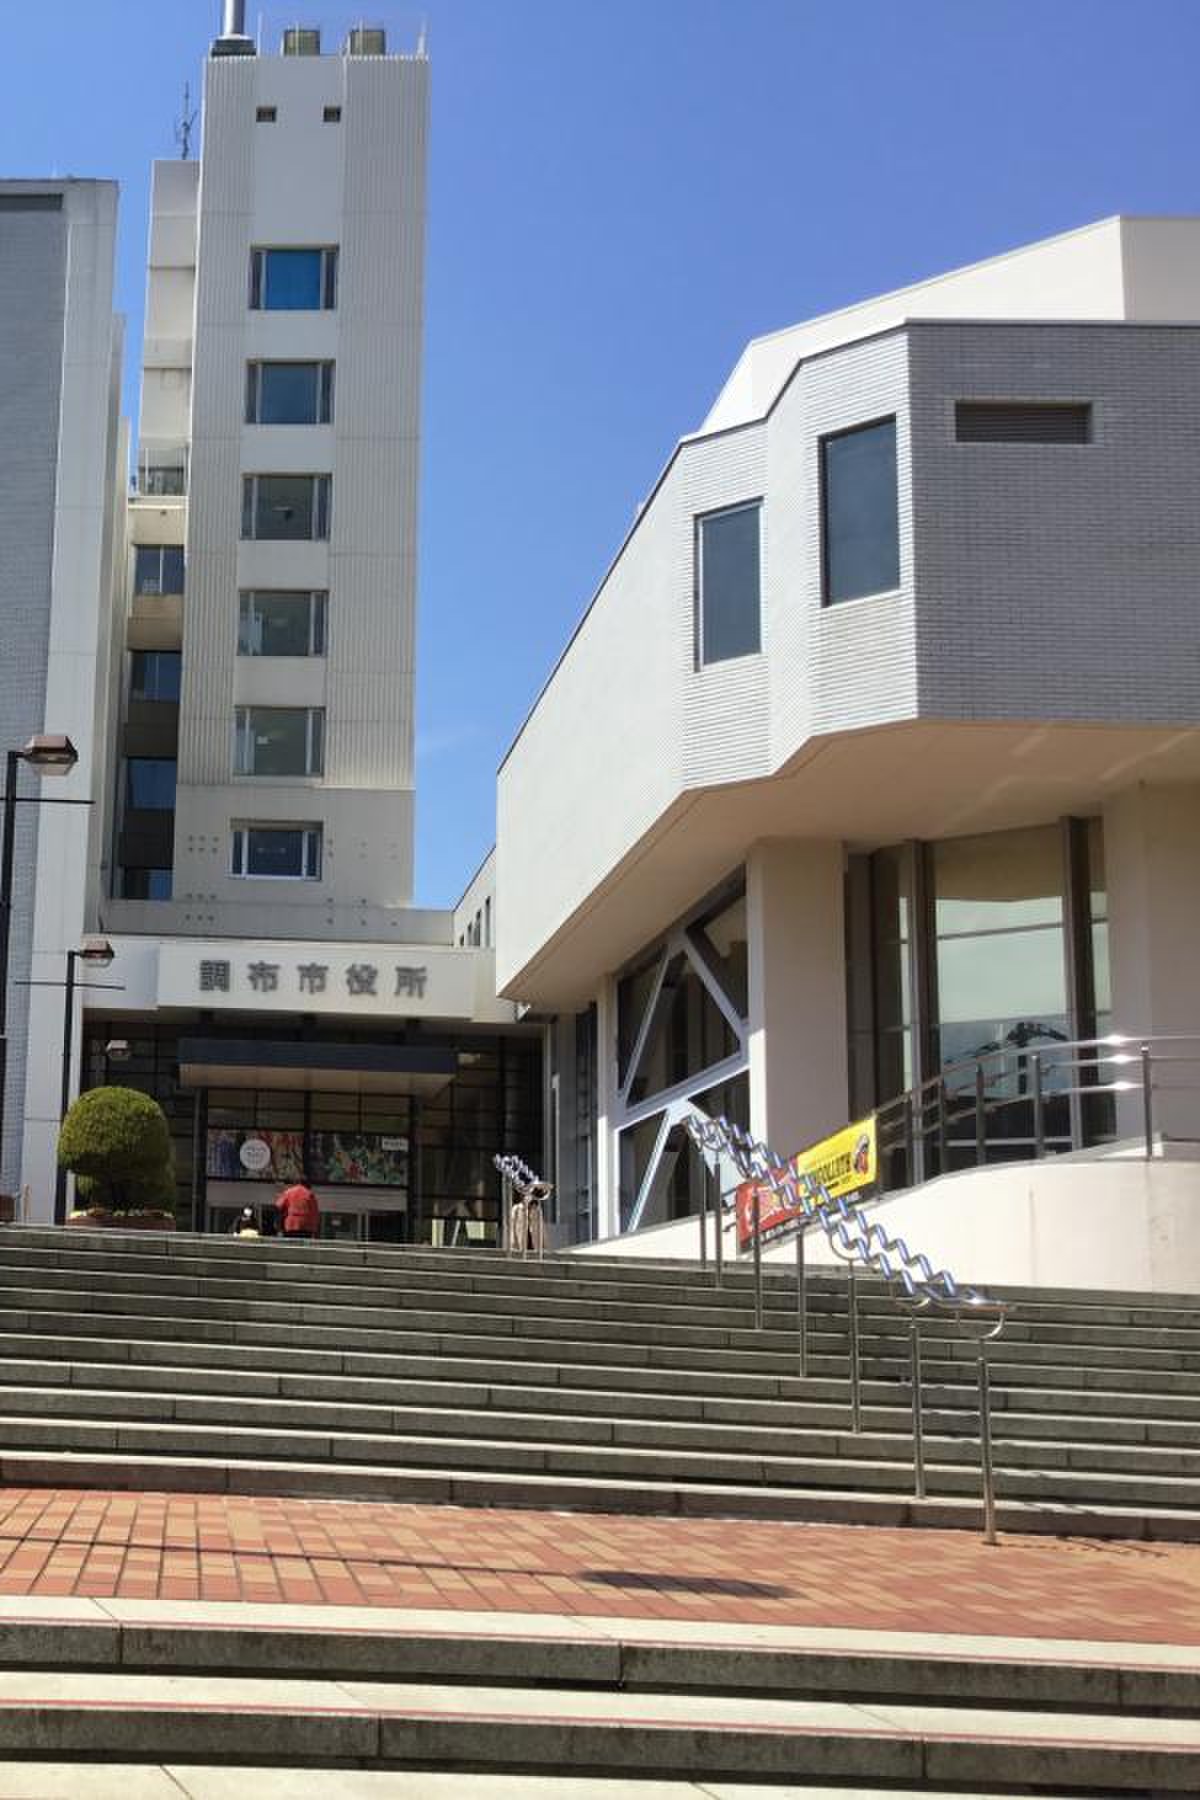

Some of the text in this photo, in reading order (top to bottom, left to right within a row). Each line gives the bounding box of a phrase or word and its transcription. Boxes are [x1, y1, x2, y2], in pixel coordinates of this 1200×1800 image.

[199, 959, 428, 999] 調布市役所
